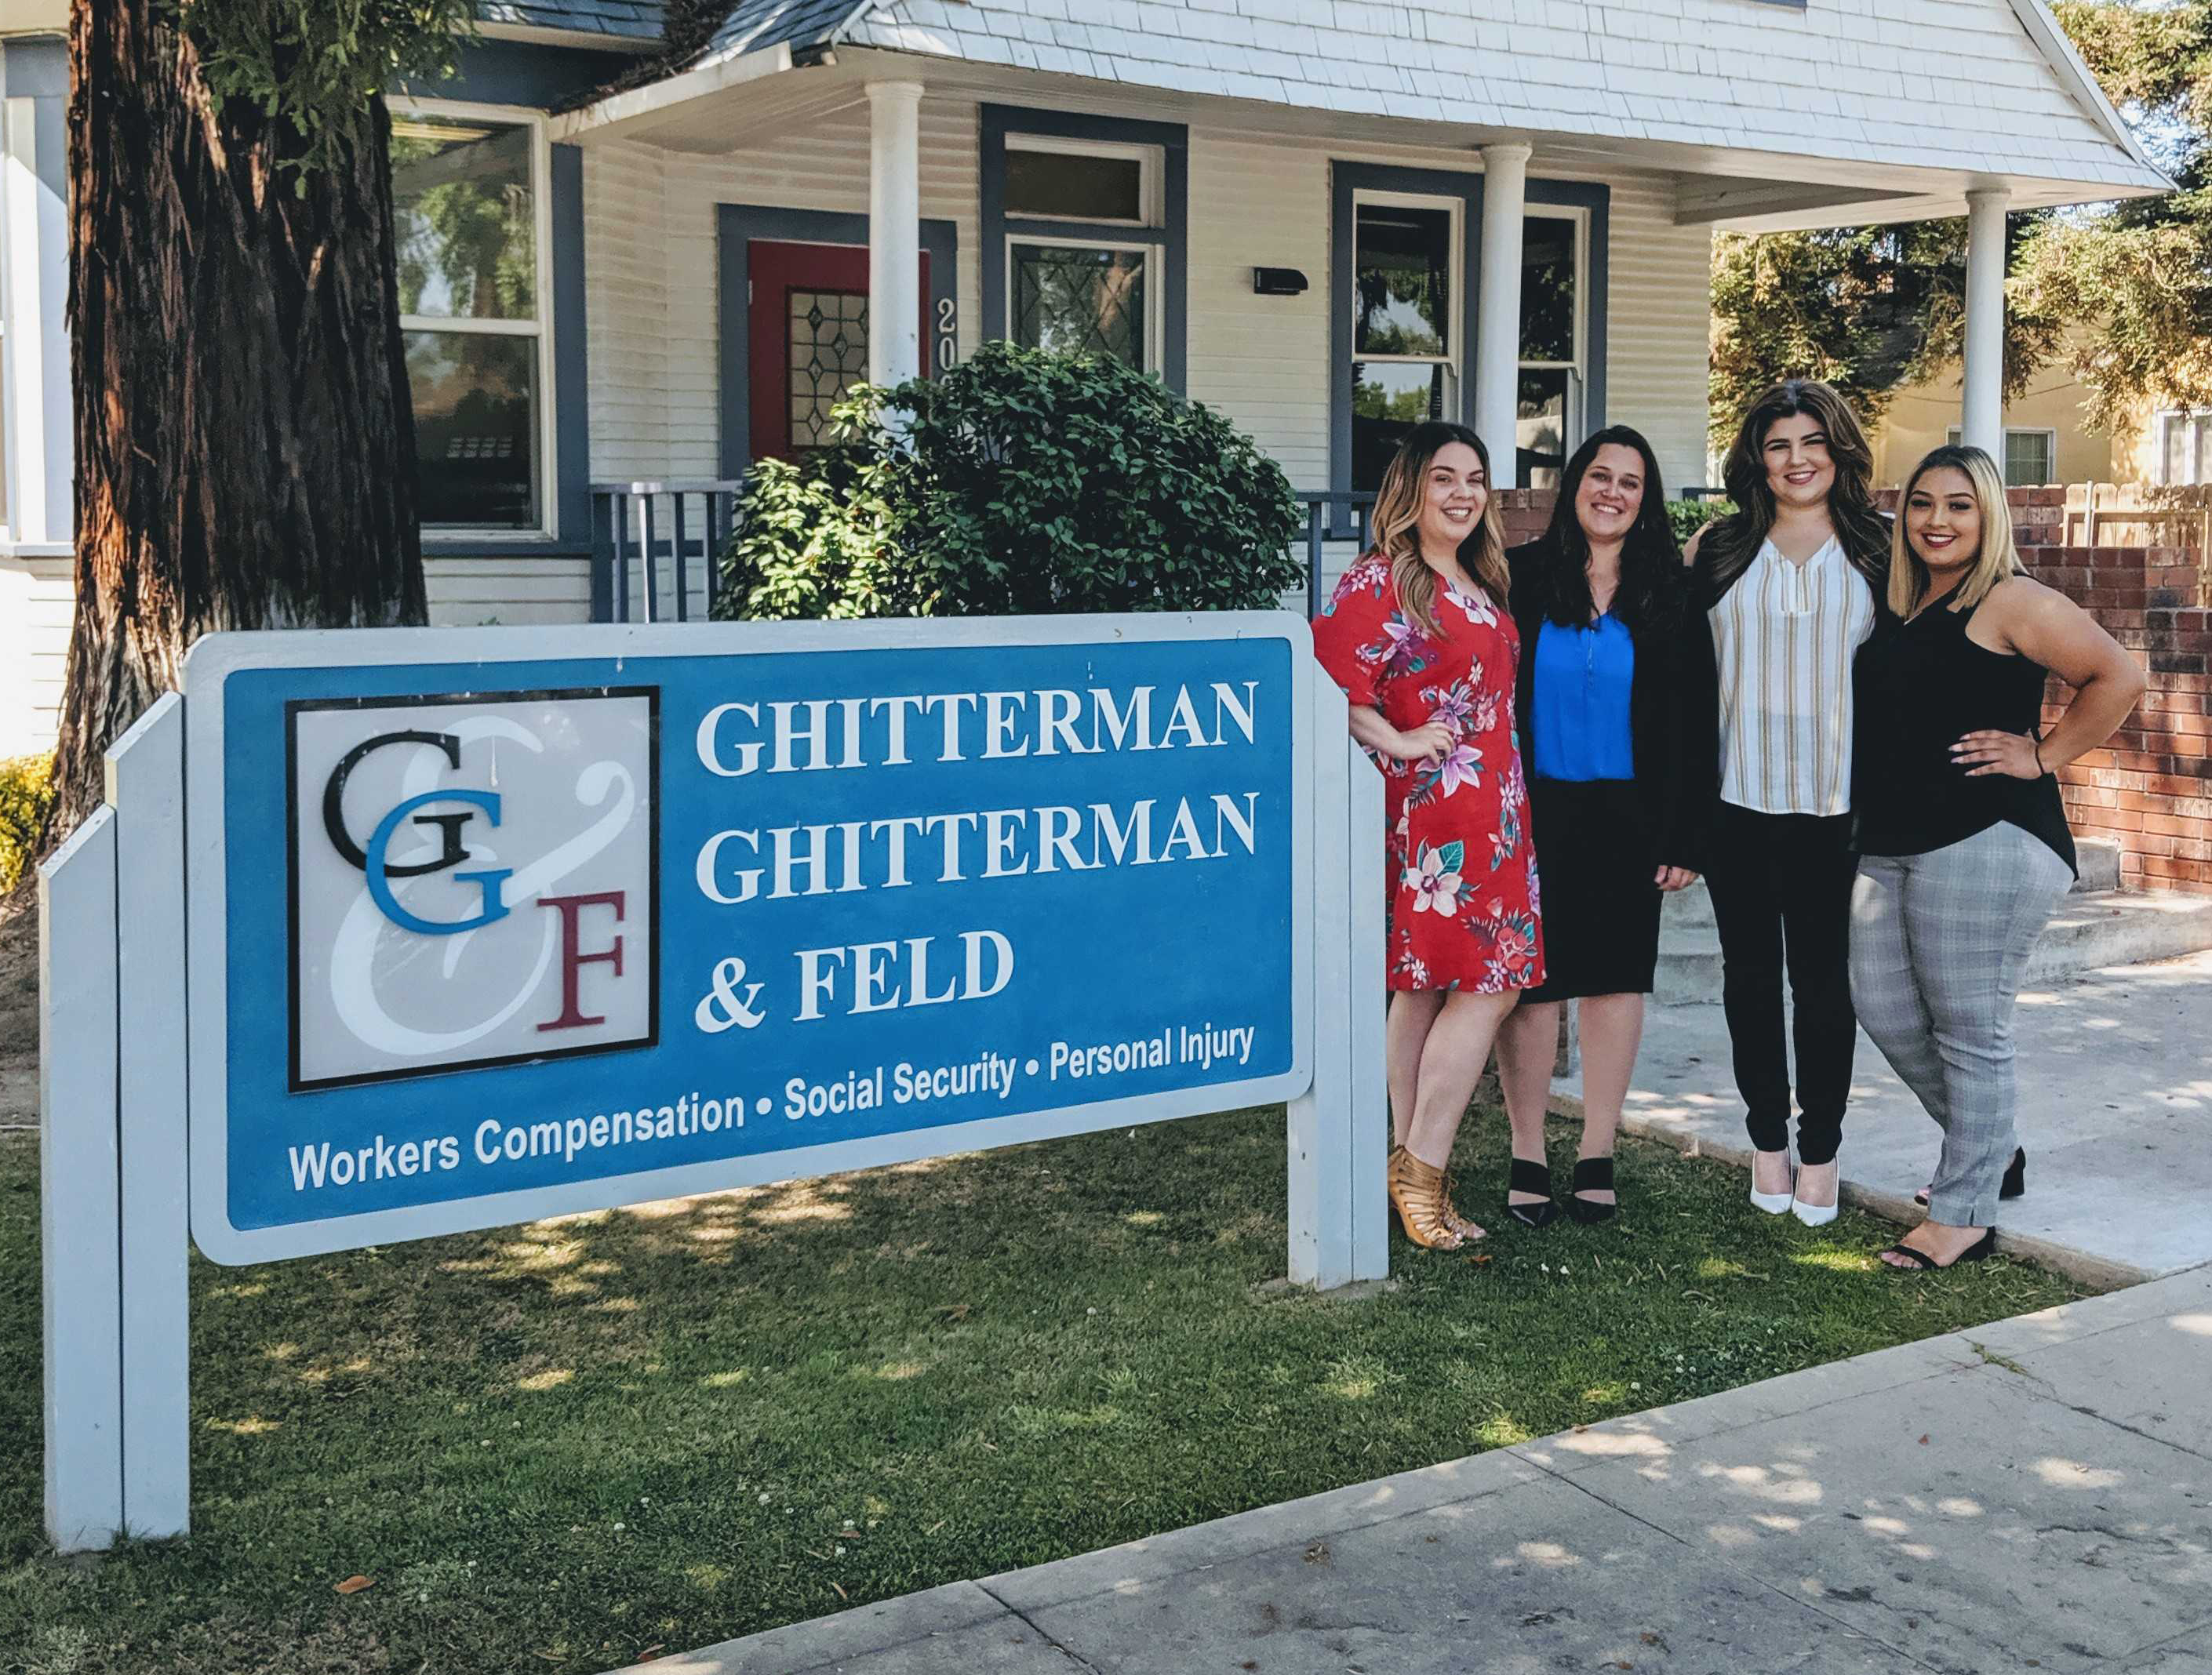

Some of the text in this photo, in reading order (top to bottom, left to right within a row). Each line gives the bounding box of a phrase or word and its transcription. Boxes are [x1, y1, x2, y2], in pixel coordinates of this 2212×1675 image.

[937, 298, 955, 386] 20
[695, 681, 1260, 777] GHITTERMAN
[695, 791, 1260, 904] GHITTERMAN
[694, 929, 1015, 1034] & FELD
[289, 1023, 1255, 1191] Workers Compensation Social Security Personal Injury
